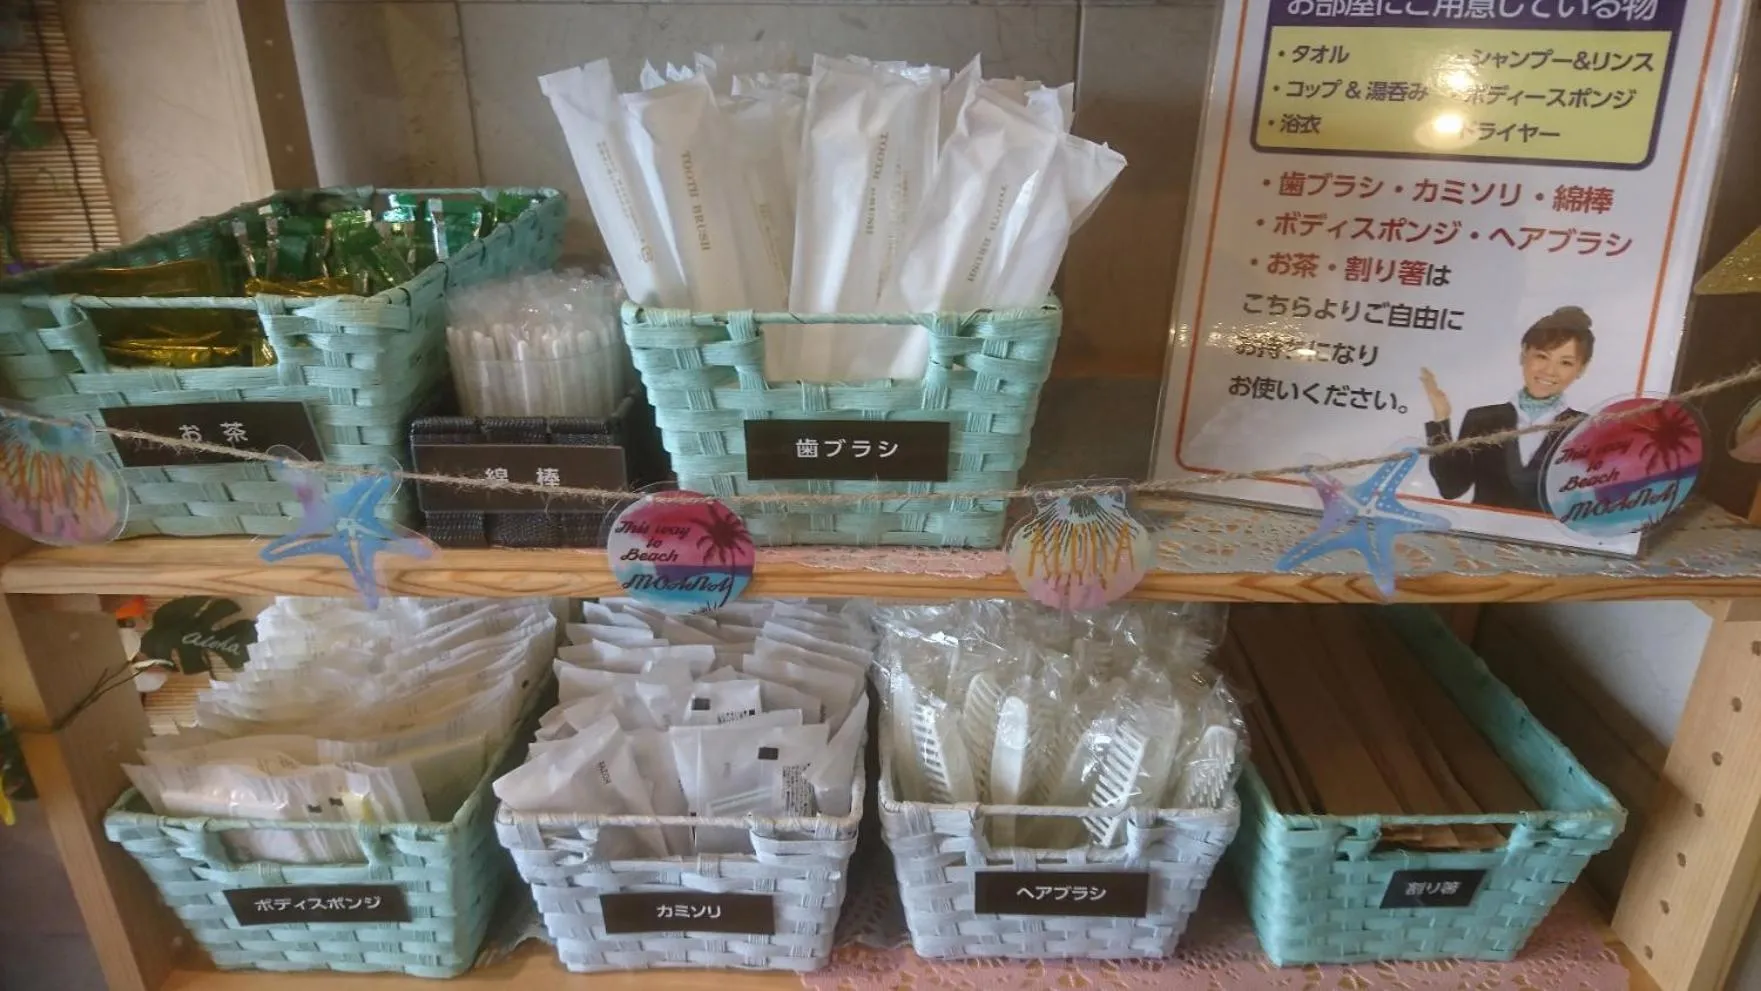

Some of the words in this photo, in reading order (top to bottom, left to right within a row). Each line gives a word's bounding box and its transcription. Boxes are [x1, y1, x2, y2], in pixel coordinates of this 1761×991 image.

[680, 150, 700, 198] TOOTH
[692, 204, 712, 251] BRUSH
[1242, 292, 1466, 331] こちらよりご自由に
[1228, 374, 1409, 414] お使いください。
[795, 438, 899, 458] 歯ブラシ
[615, 520, 651, 535] This
[655, 524, 692, 540] way
[619, 548, 680, 562] Beach
[1016, 884, 1108, 901] ヘアブラシ
[253, 895, 382, 912] ボディスポンジ
[656, 904, 722, 919] カミソリ
